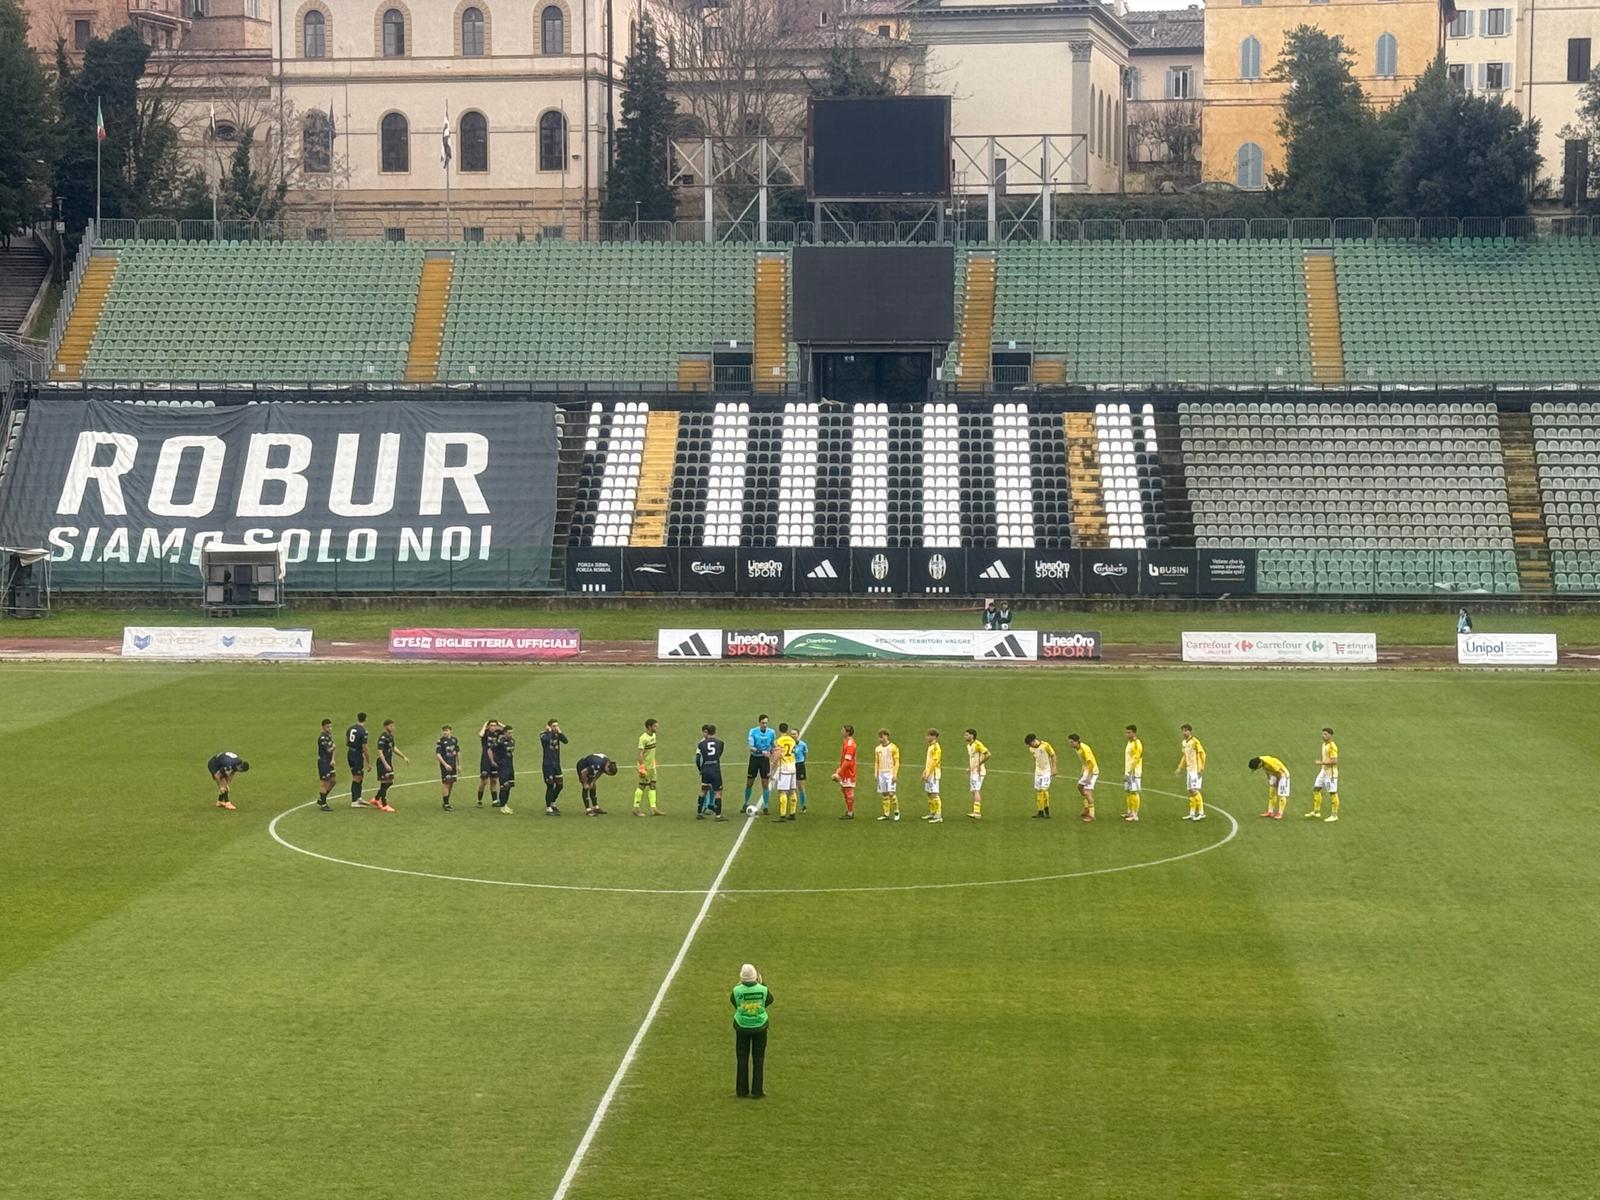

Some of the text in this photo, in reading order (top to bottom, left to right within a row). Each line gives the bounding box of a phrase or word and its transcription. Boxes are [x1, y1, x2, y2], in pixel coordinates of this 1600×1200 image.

[56, 431, 490, 517] ROBUR
[398, 525, 492, 562] NOI
[691, 561, 725, 575] Carlsberg
[748, 559, 783, 570] LineaOro
[1035, 560, 1070, 570] LineaOro
[1093, 562, 1128, 576] Carlsberg
[1159, 566, 1189, 575] BUSINI
[748, 569, 783, 578] SPORT
[1035, 569, 1070, 578] SPORT
[435, 637, 516, 648] BIGLIETTERIA
[516, 638, 577, 649] UFFICIALE
[727, 632, 778, 645] LineaOro
[1042, 633, 1095, 647] LineaOro
[1186, 640, 1232, 649] Carrefour
[1256, 640, 1302, 649] Carrefour
[728, 644, 777, 656] SPORT
[1043, 646, 1094, 657] SPORT
[1465, 641, 1504, 656] Unipol
[350, 729, 357, 743] 6
[707, 741, 716, 756] 5
